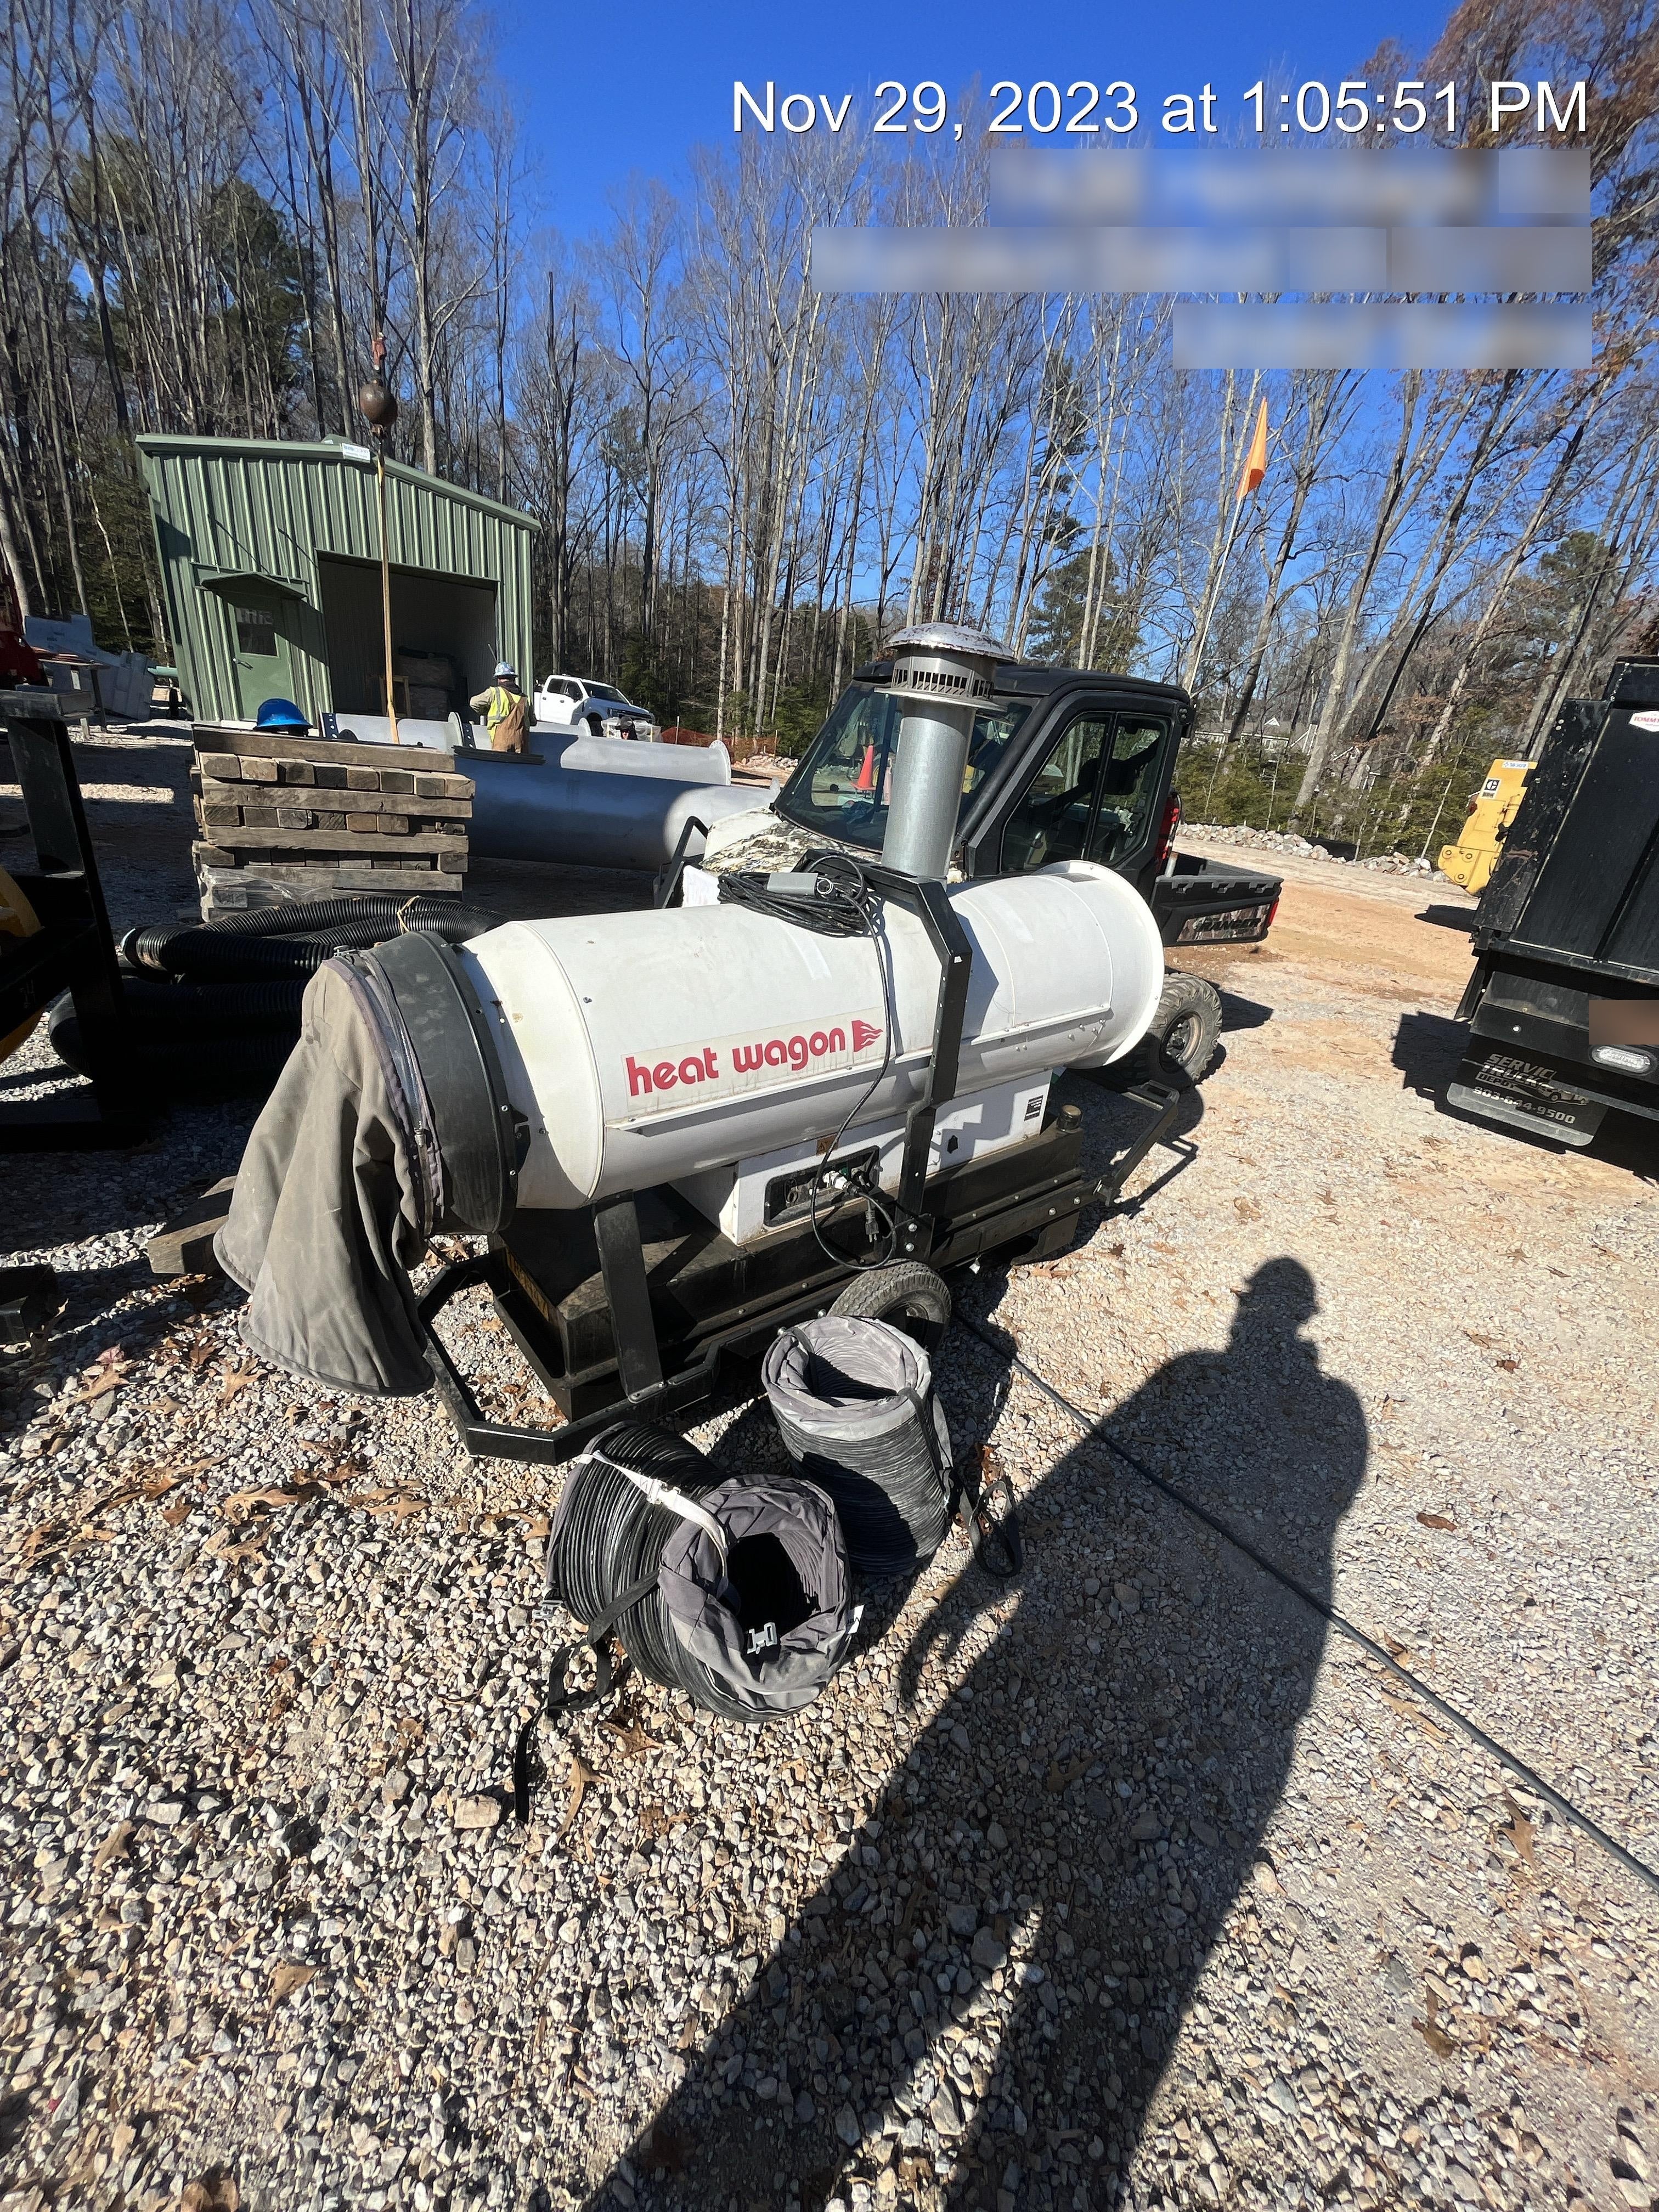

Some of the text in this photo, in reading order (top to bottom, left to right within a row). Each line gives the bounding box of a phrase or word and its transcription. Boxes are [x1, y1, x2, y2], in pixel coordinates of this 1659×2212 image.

[1197, 917, 1262, 933] RANGER
[626, 1028, 845, 1096] heat wagon
[1481, 1062, 1541, 1087] TRUCK
[1486, 1053, 1557, 1080] SERVIC
[1477, 1073, 1517, 1089] DEPOT
